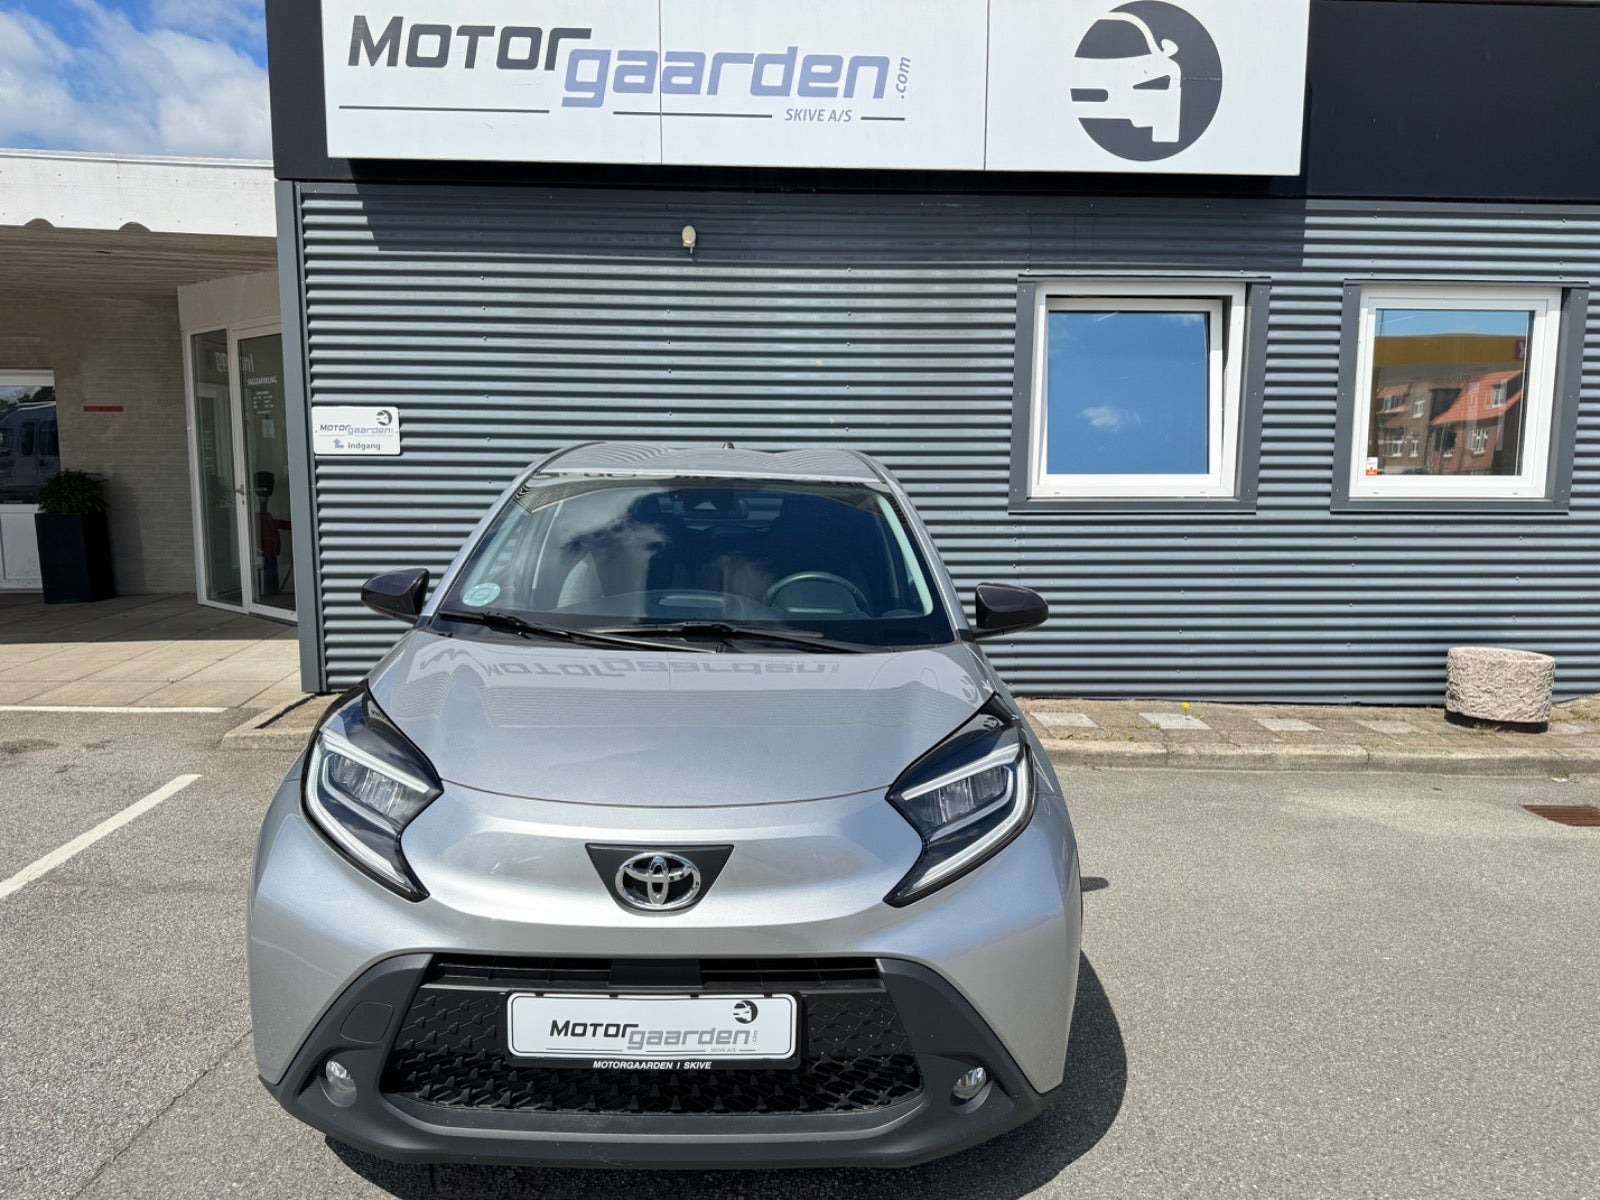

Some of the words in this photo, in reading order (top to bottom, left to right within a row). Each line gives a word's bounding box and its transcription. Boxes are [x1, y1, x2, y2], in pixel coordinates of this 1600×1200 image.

[895, 56, 911, 99] .com
[784, 108, 826, 121] SKIVE
[827, 109, 853, 122] A/S
[347, 442, 381, 451] Indgang
[592, 1060, 673, 1070] MOTORGAARDEN
[683, 1061, 713, 1070] SKIVE
